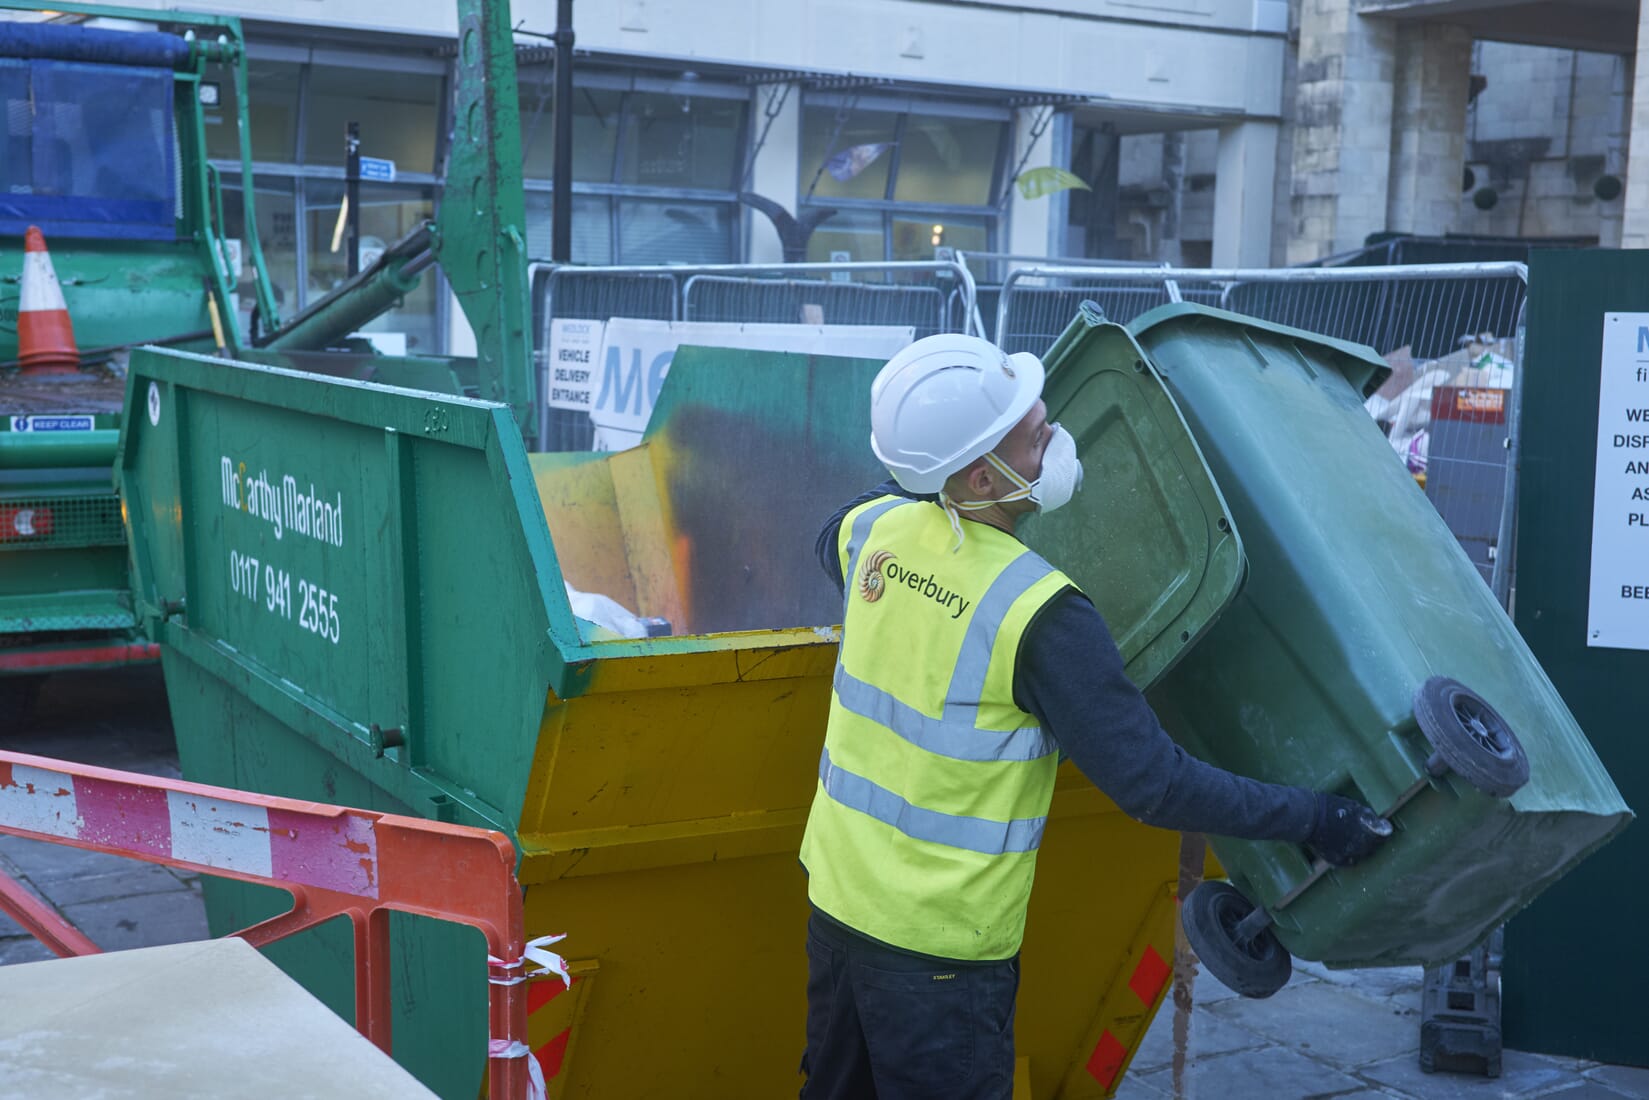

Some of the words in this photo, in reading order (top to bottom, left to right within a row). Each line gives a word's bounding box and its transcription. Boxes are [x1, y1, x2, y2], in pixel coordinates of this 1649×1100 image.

[558, 348, 591, 363] VEHICLE
[554, 367, 591, 383] DELIVERY
[552, 387, 591, 404] ENTRANCE
[34, 420, 58, 430] KEEP
[60, 420, 90, 430] CLEAR
[221, 455, 282, 540] McCarthy
[283, 474, 343, 548] Marland
[230, 549, 260, 603] 0117
[265, 564, 292, 620] 941
[299, 578, 340, 645] 2555
[887, 563, 970, 619] overbury
